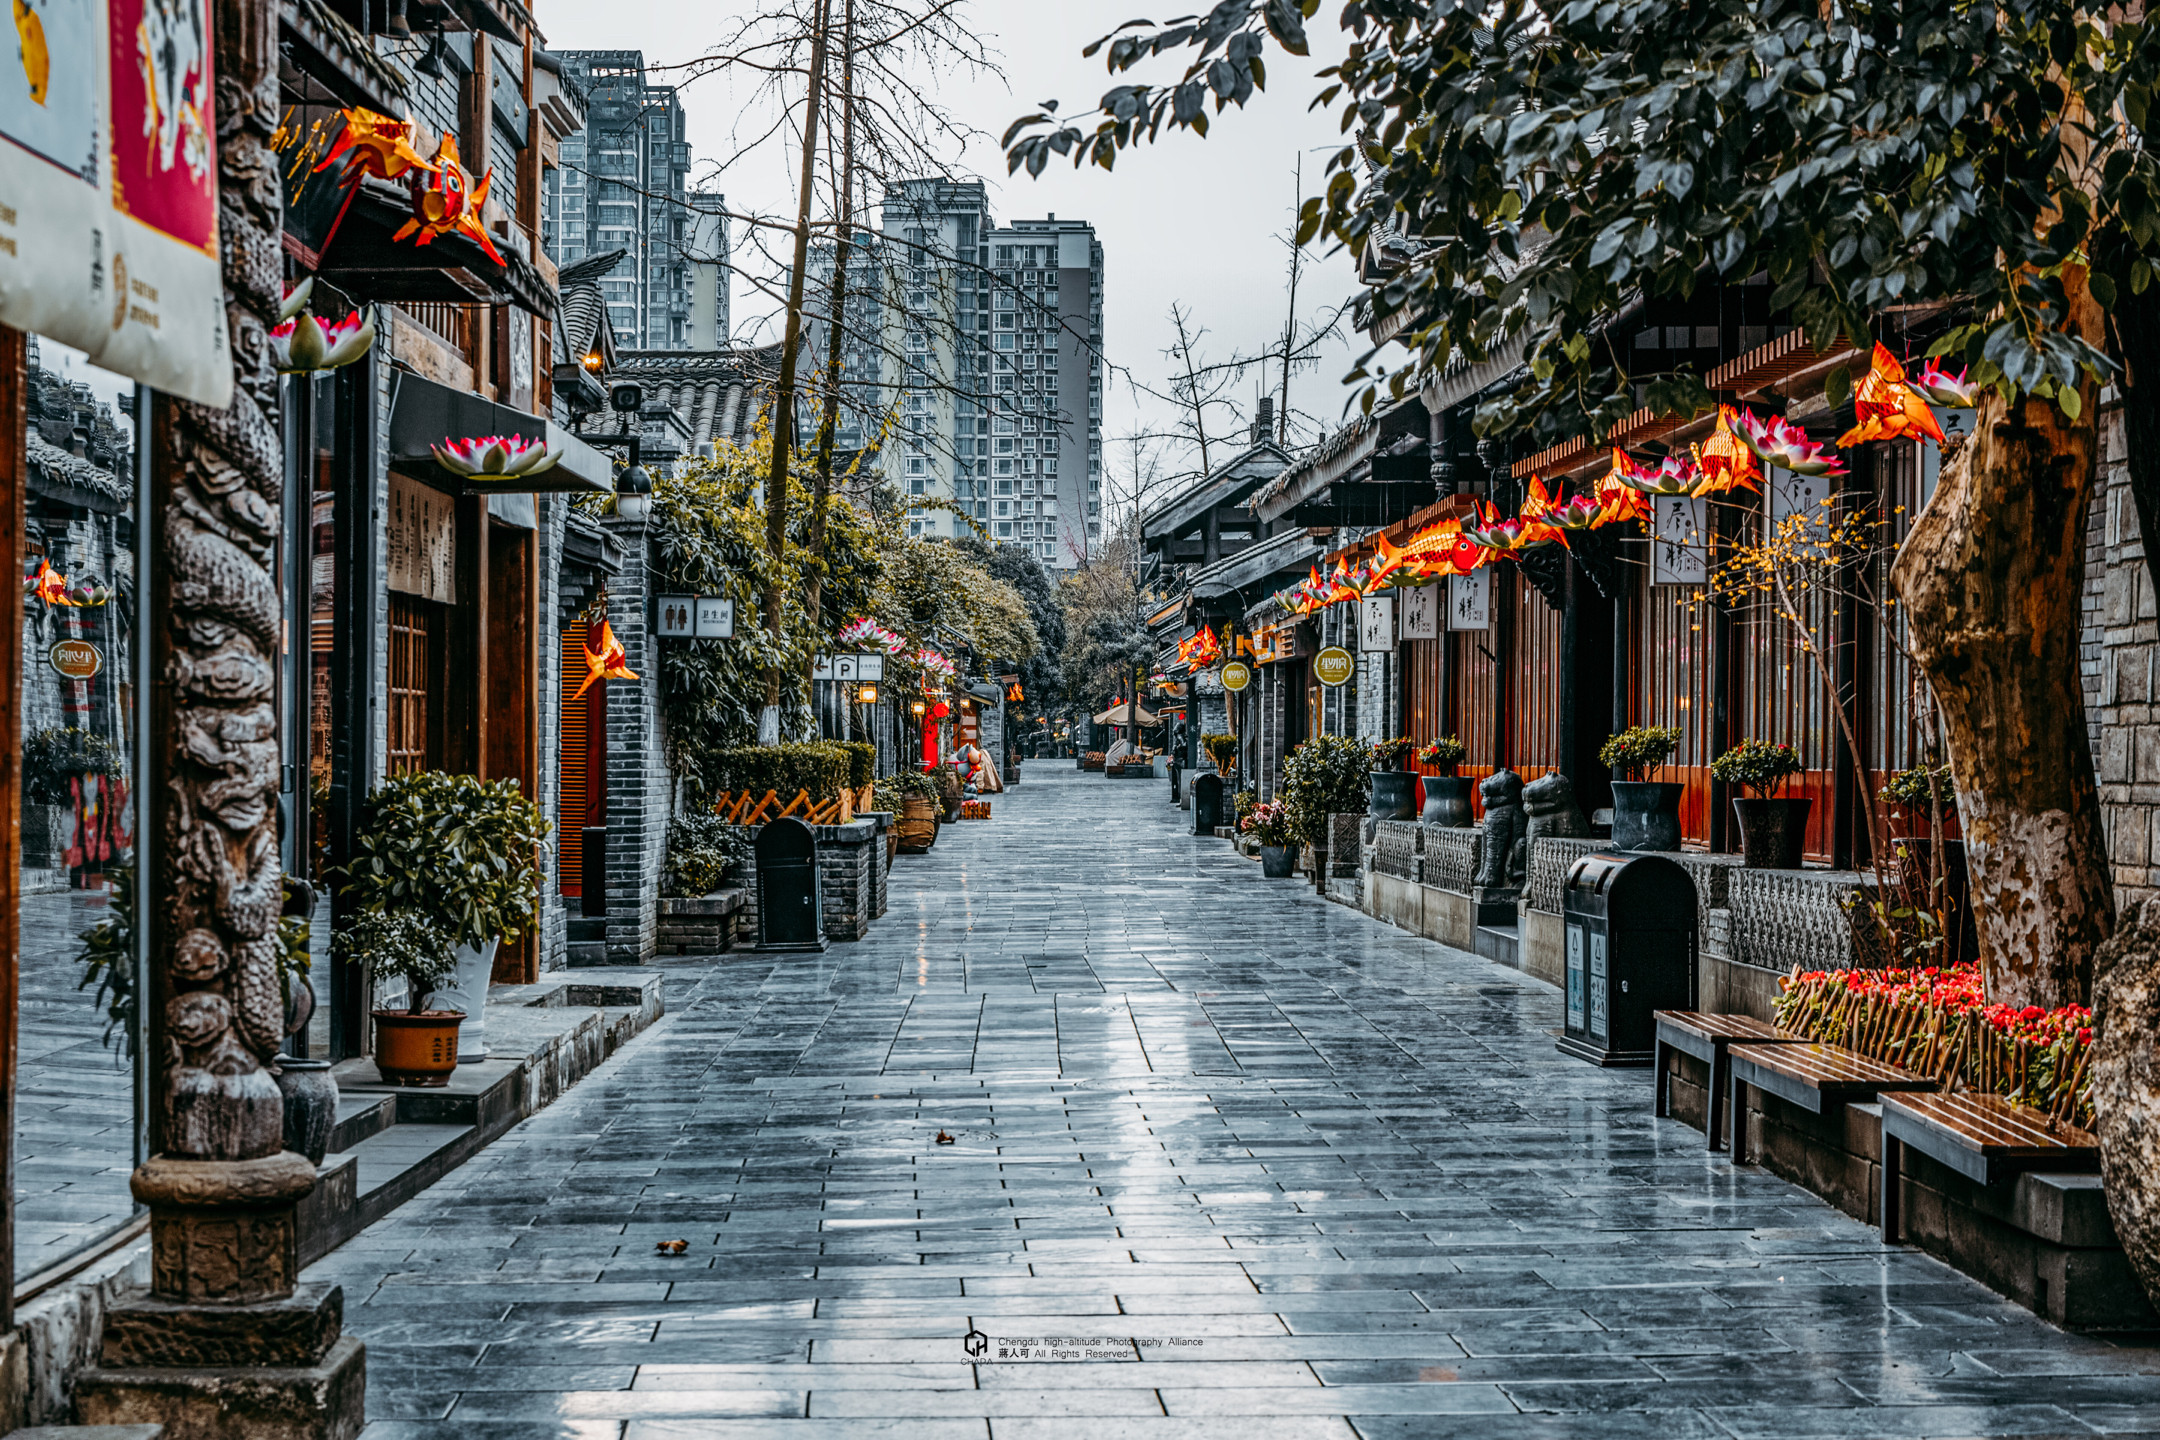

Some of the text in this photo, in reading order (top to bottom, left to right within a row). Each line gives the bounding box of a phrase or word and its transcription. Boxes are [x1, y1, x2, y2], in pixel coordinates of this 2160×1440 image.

[701, 609, 729, 619] 卫生间
[841, 663, 850, 676] P
